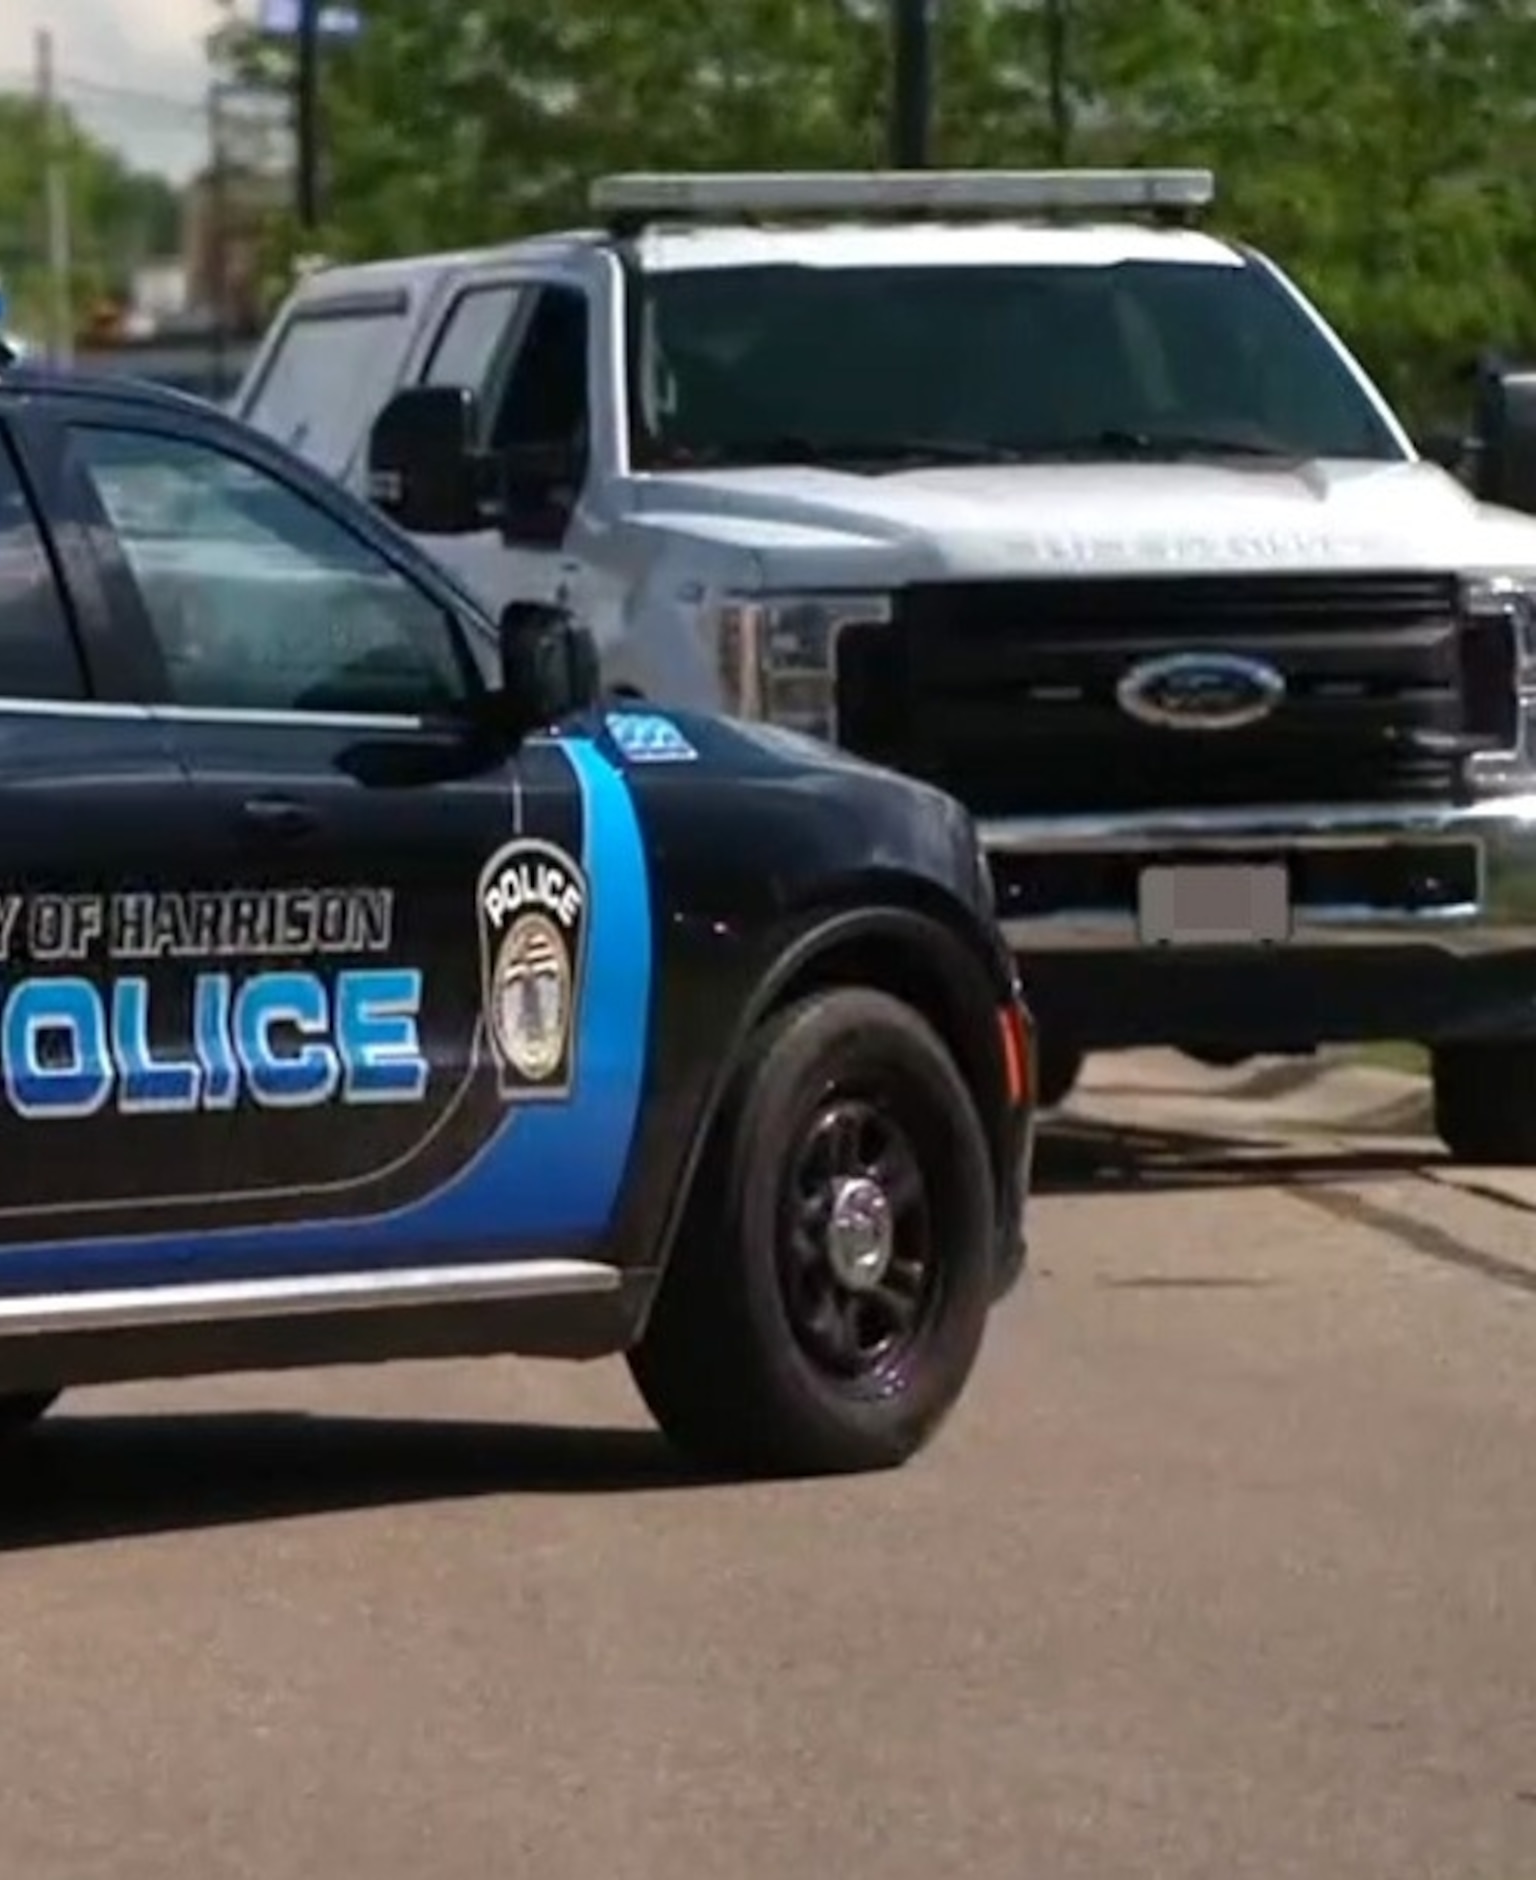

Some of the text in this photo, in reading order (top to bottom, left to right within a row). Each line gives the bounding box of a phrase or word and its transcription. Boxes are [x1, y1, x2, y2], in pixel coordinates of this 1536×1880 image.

[28, 895, 102, 958] OF
[109, 888, 394, 958] HARRISON
[484, 863, 582, 928] POLICE
